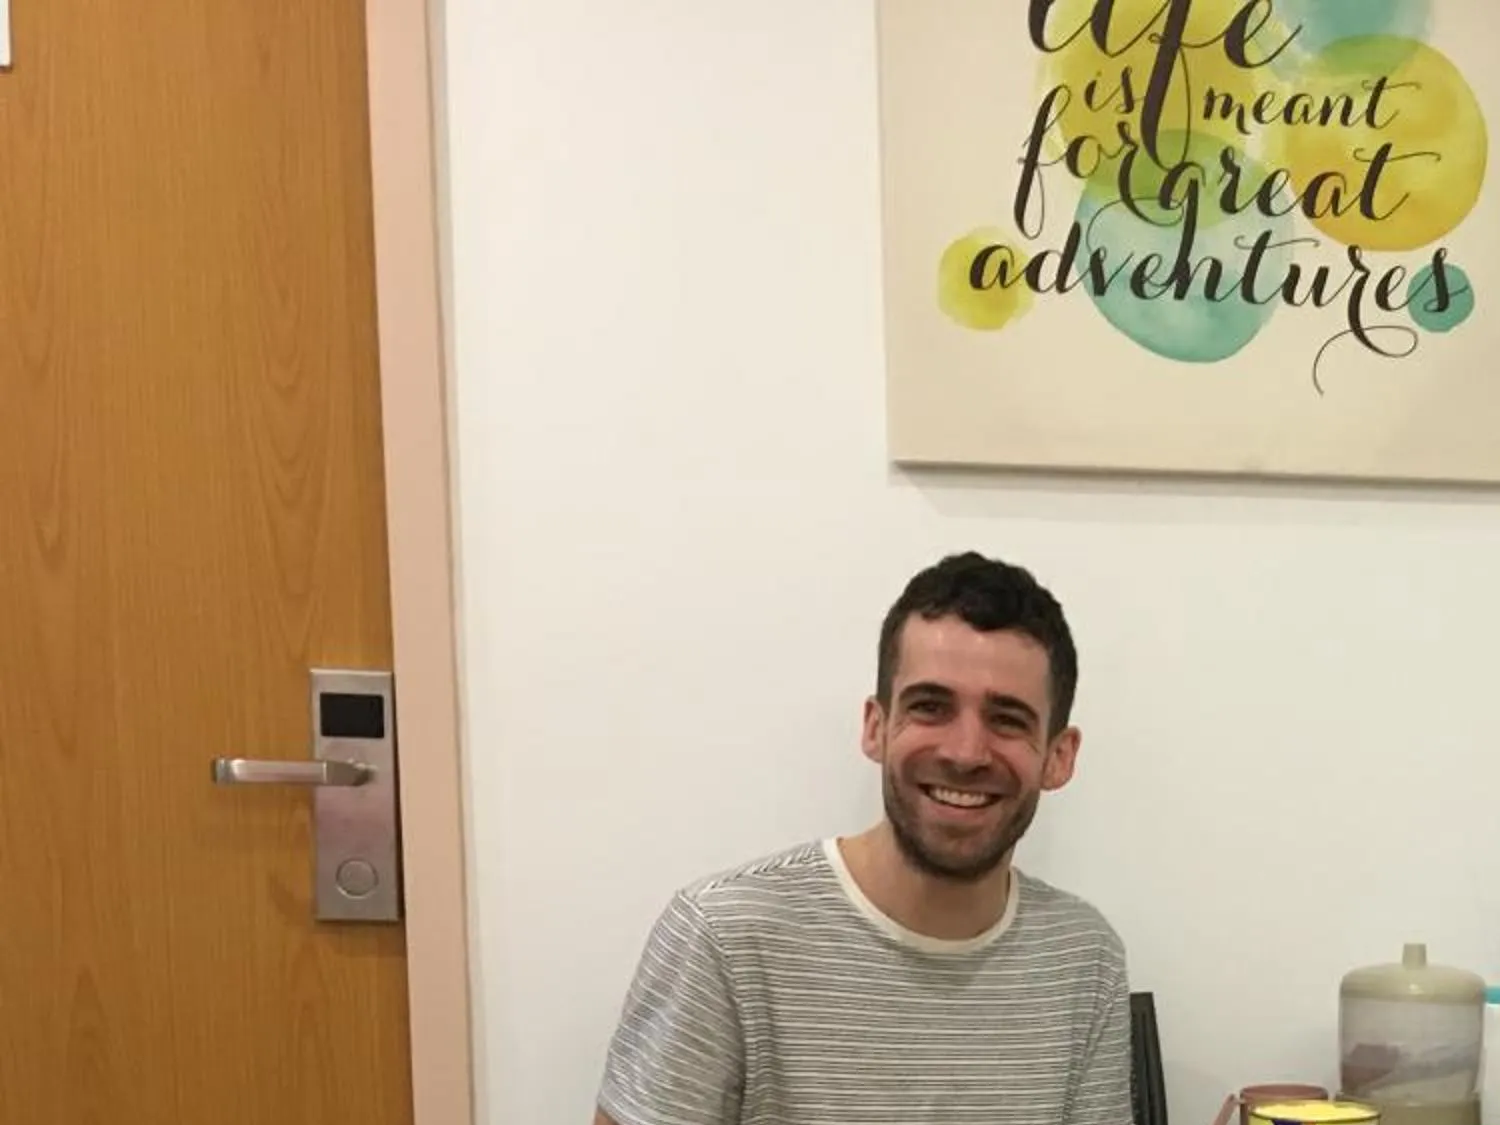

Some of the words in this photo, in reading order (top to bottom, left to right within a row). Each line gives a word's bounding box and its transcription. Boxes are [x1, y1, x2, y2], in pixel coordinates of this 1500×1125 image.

[1084, 66, 1134, 114] is
[1203, 76, 1421, 134] meant
[1013, 85, 1184, 240] for
[1159, 142, 1441, 275] great
[969, 222, 1469, 358] adventures
